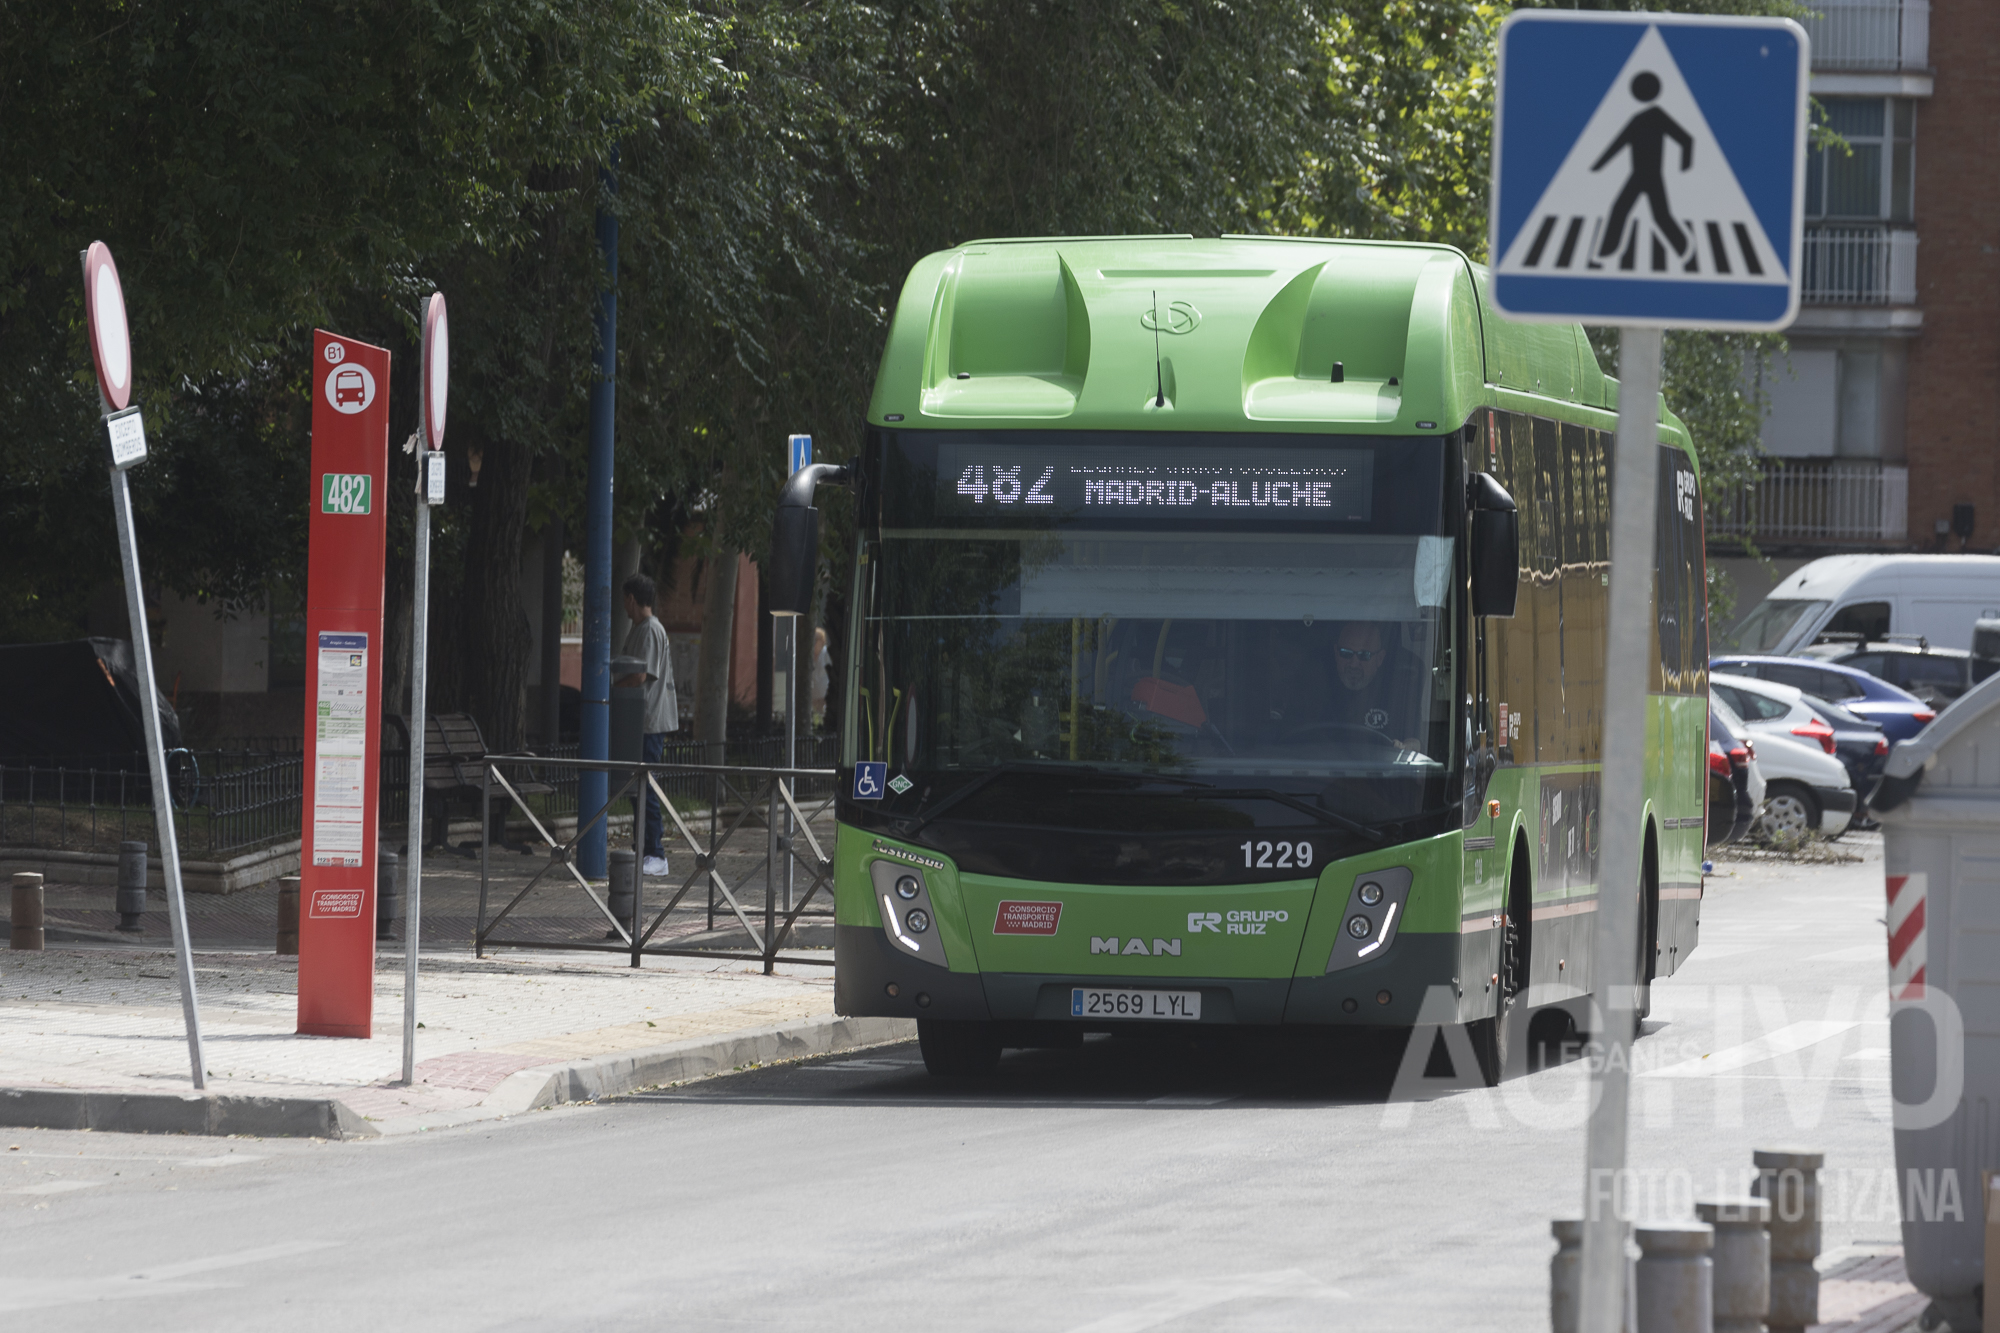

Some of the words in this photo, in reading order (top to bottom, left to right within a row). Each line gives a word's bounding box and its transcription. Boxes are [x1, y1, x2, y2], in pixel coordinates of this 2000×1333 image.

[328, 347, 342, 359] B1
[957, 465, 1054, 503] 482
[328, 475, 365, 512] 482
[1085, 479, 1332, 507] MADRID-ALUCHE
[892, 780, 908, 789] GNC
[1240, 841, 1313, 868] 1229
[1008, 905, 1057, 914] CONSORCIO
[1003, 913, 1055, 921] TRANSPORTES
[1226, 910, 1289, 922] GRUPO
[1022, 921, 1053, 929] MADRID
[1226, 923, 1267, 935] RUIZ
[1090, 936, 1182, 956] MAN
[1088, 993, 1143, 1014] 2569
[1153, 995, 1193, 1016] LYL
